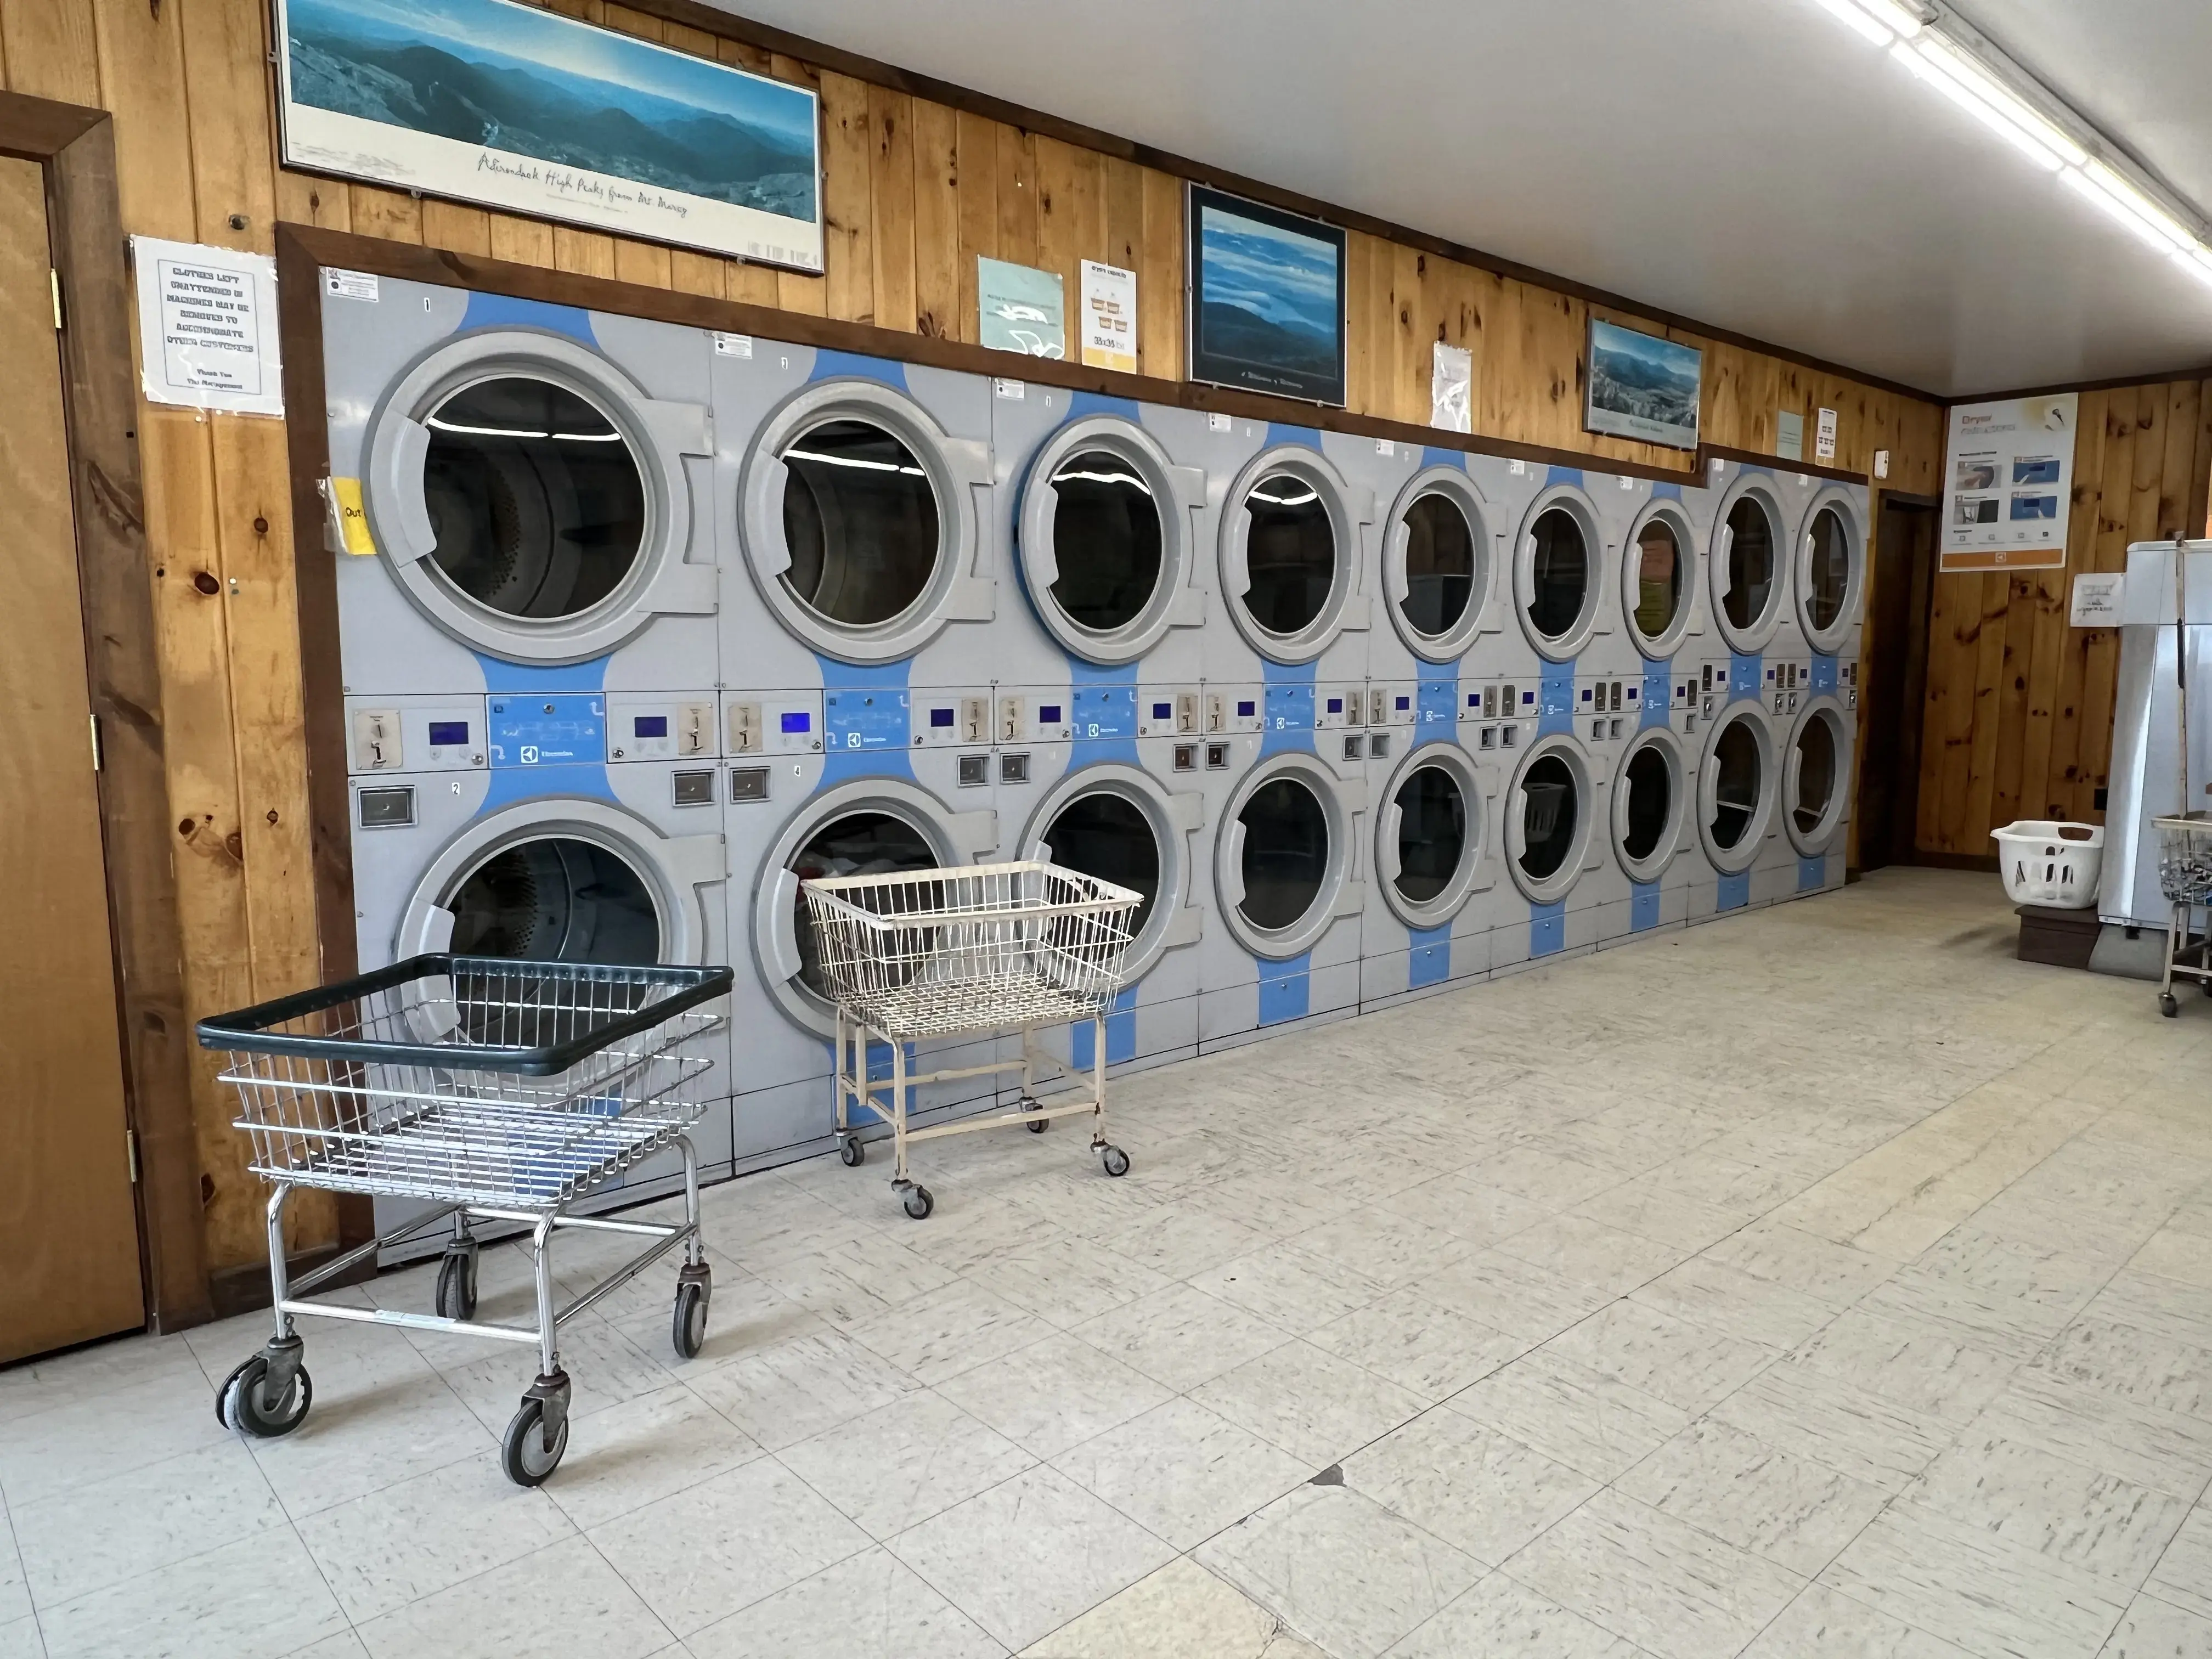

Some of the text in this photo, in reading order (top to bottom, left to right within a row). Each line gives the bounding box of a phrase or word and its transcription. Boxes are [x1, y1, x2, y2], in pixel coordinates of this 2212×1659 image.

[545, 168, 573, 194] High
[578, 178, 603, 200] Peaks
[608, 185, 633, 203] from
[658, 195, 687, 218] Marcy
[217, 274, 239, 284] LEFT
[225, 316, 238, 324] TO
[453, 783, 459, 794] 2
